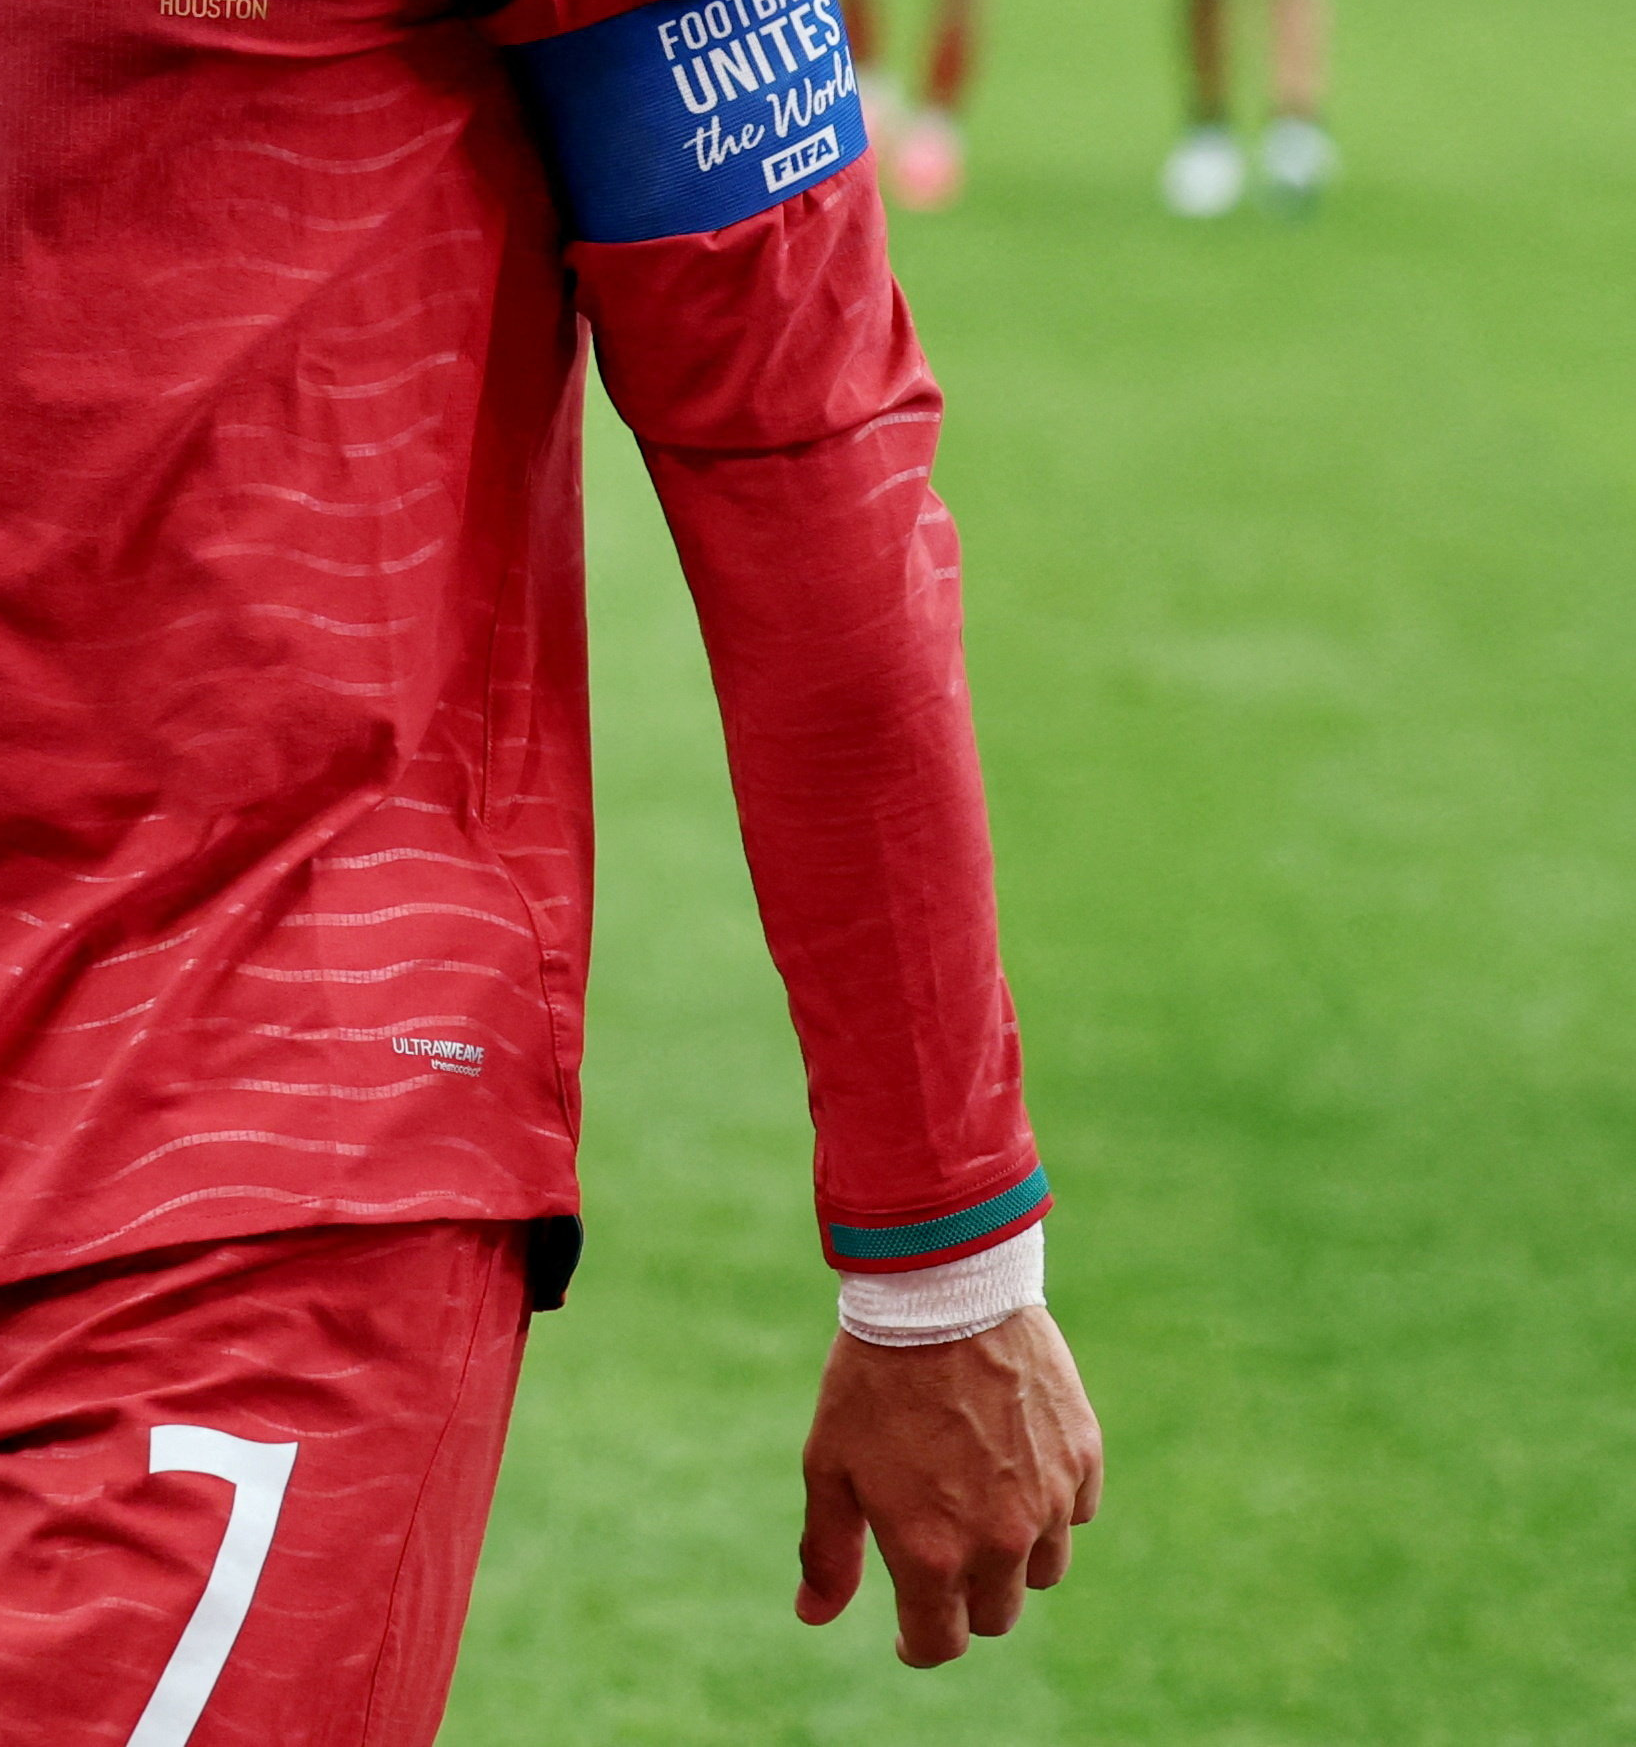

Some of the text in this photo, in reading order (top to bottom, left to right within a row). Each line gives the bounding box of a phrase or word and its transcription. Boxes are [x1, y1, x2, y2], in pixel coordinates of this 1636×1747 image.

[681, 45, 858, 173] the World
[771, 134, 834, 183] FIFA
[392, 1036, 485, 1065] ULTRAWEAVE
[125, 1423, 299, 1747] 7
